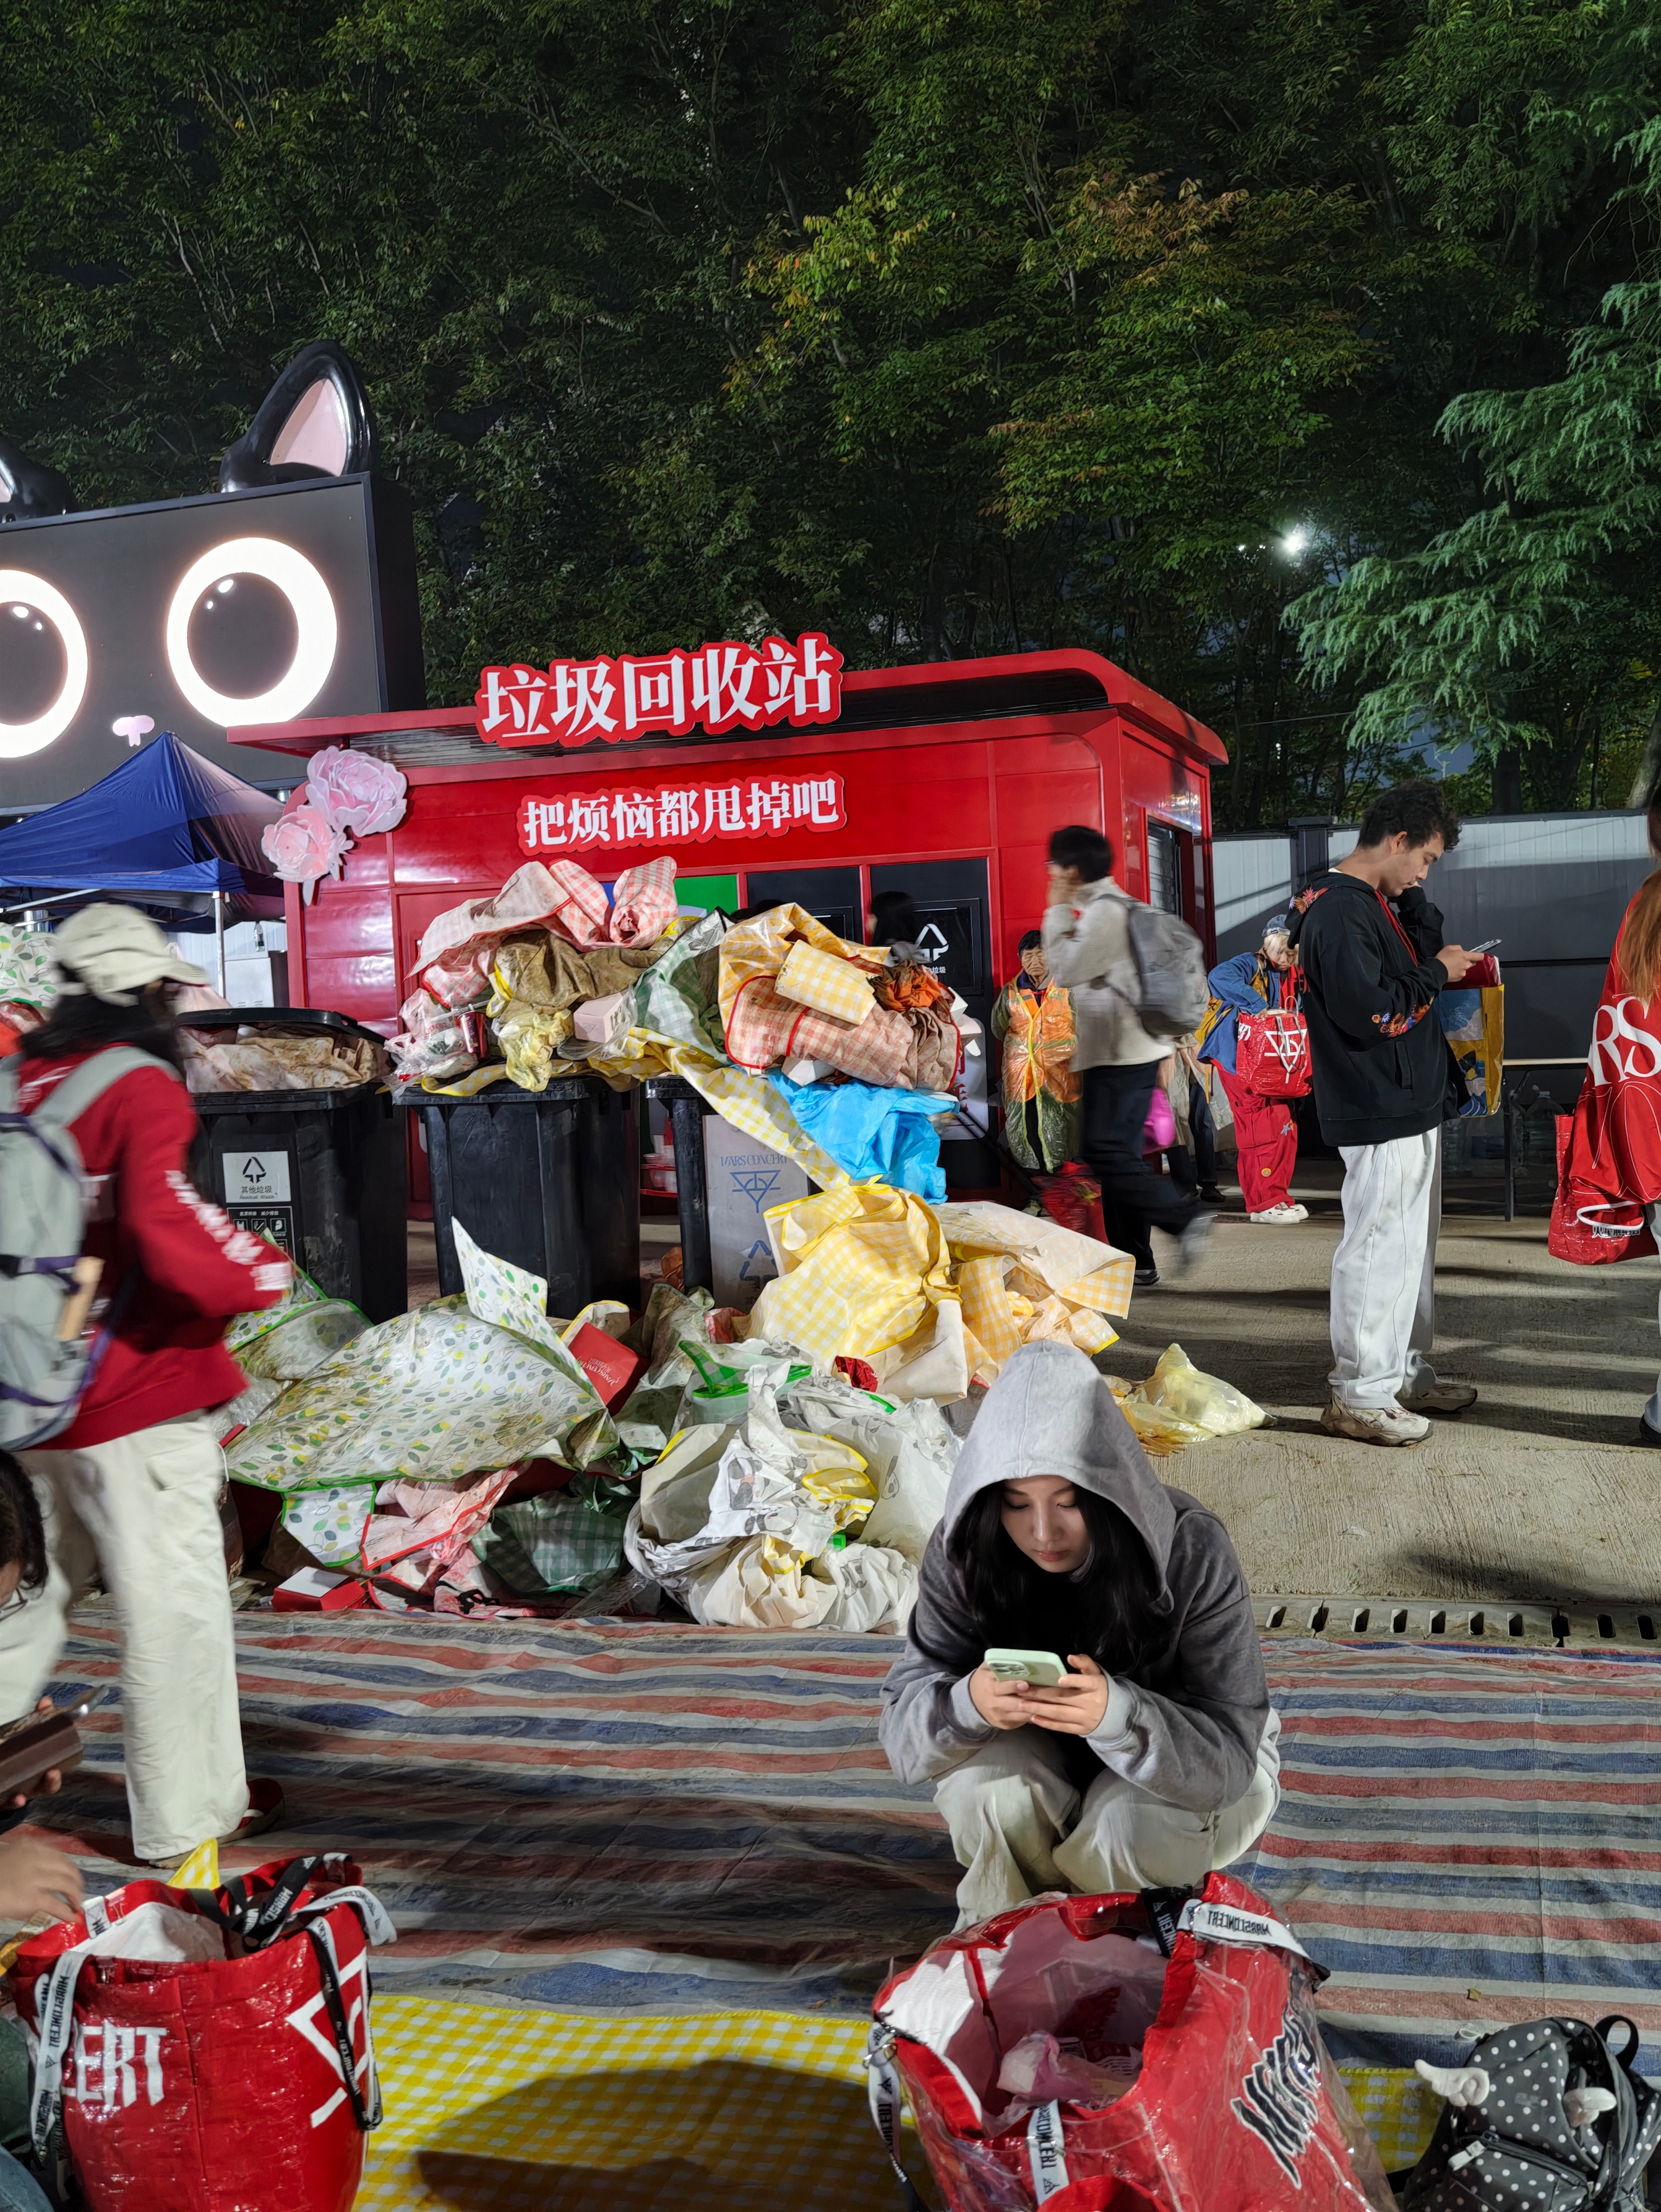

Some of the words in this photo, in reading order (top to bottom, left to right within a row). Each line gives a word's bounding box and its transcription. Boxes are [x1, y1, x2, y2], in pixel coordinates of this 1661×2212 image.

[481, 639, 833, 738] 垃圾回收站
[524, 779, 838, 847] 把烦恼都甩掉吧
[1588, 996, 1661, 1087] RS
